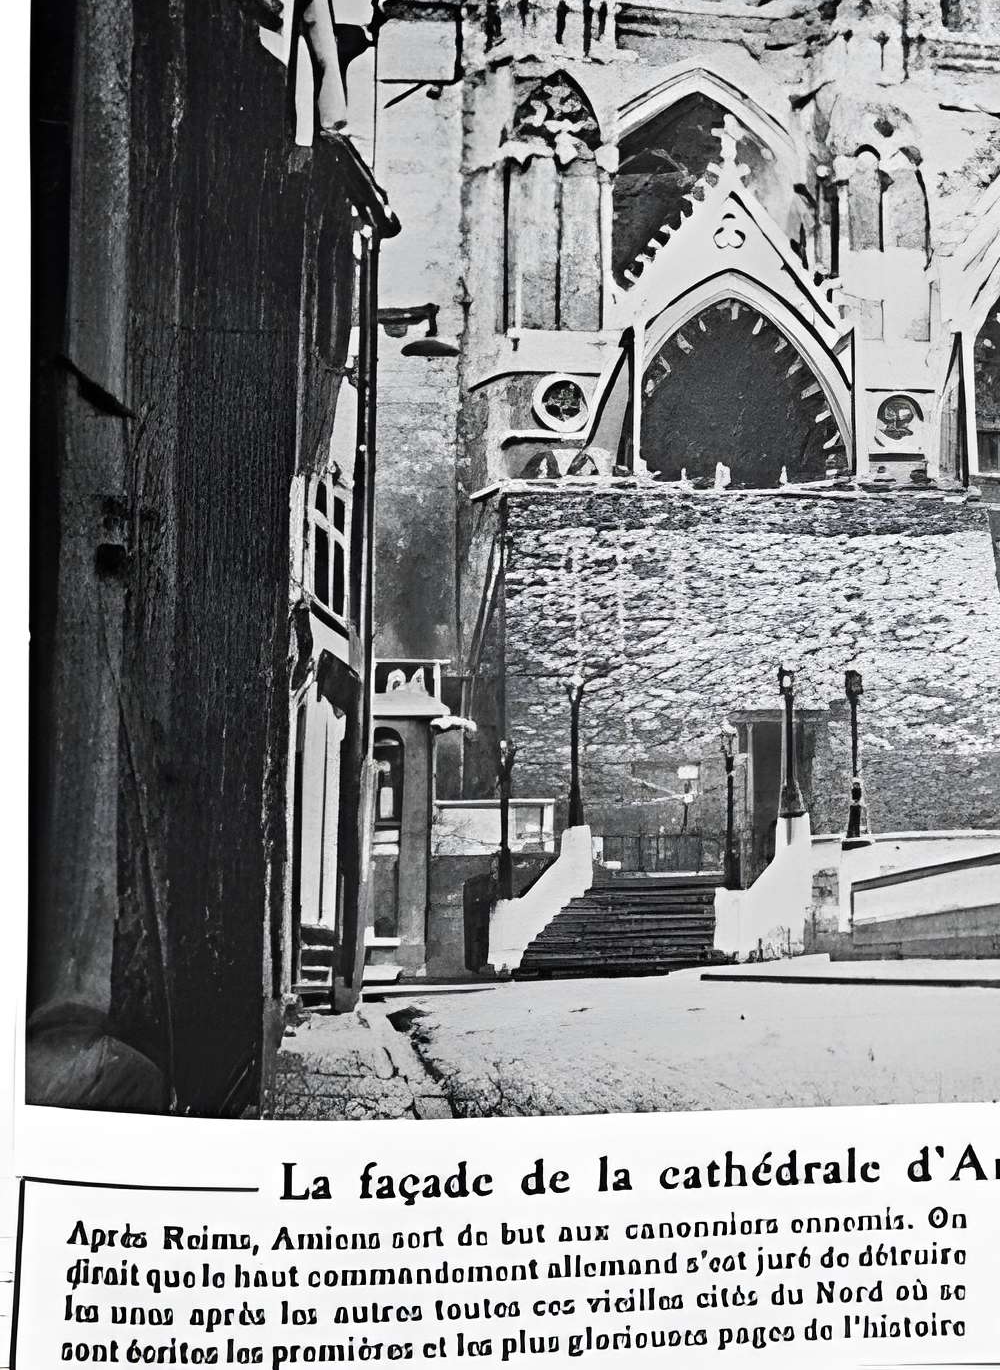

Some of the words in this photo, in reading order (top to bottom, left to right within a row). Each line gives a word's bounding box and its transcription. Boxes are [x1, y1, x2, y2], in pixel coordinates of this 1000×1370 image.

[279, 1162, 333, 1201] La
[359, 1160, 494, 1206] façade
[520, 1158, 571, 1196] de
[597, 1155, 633, 1192] la
[659, 1147, 881, 1190] cathédrale
